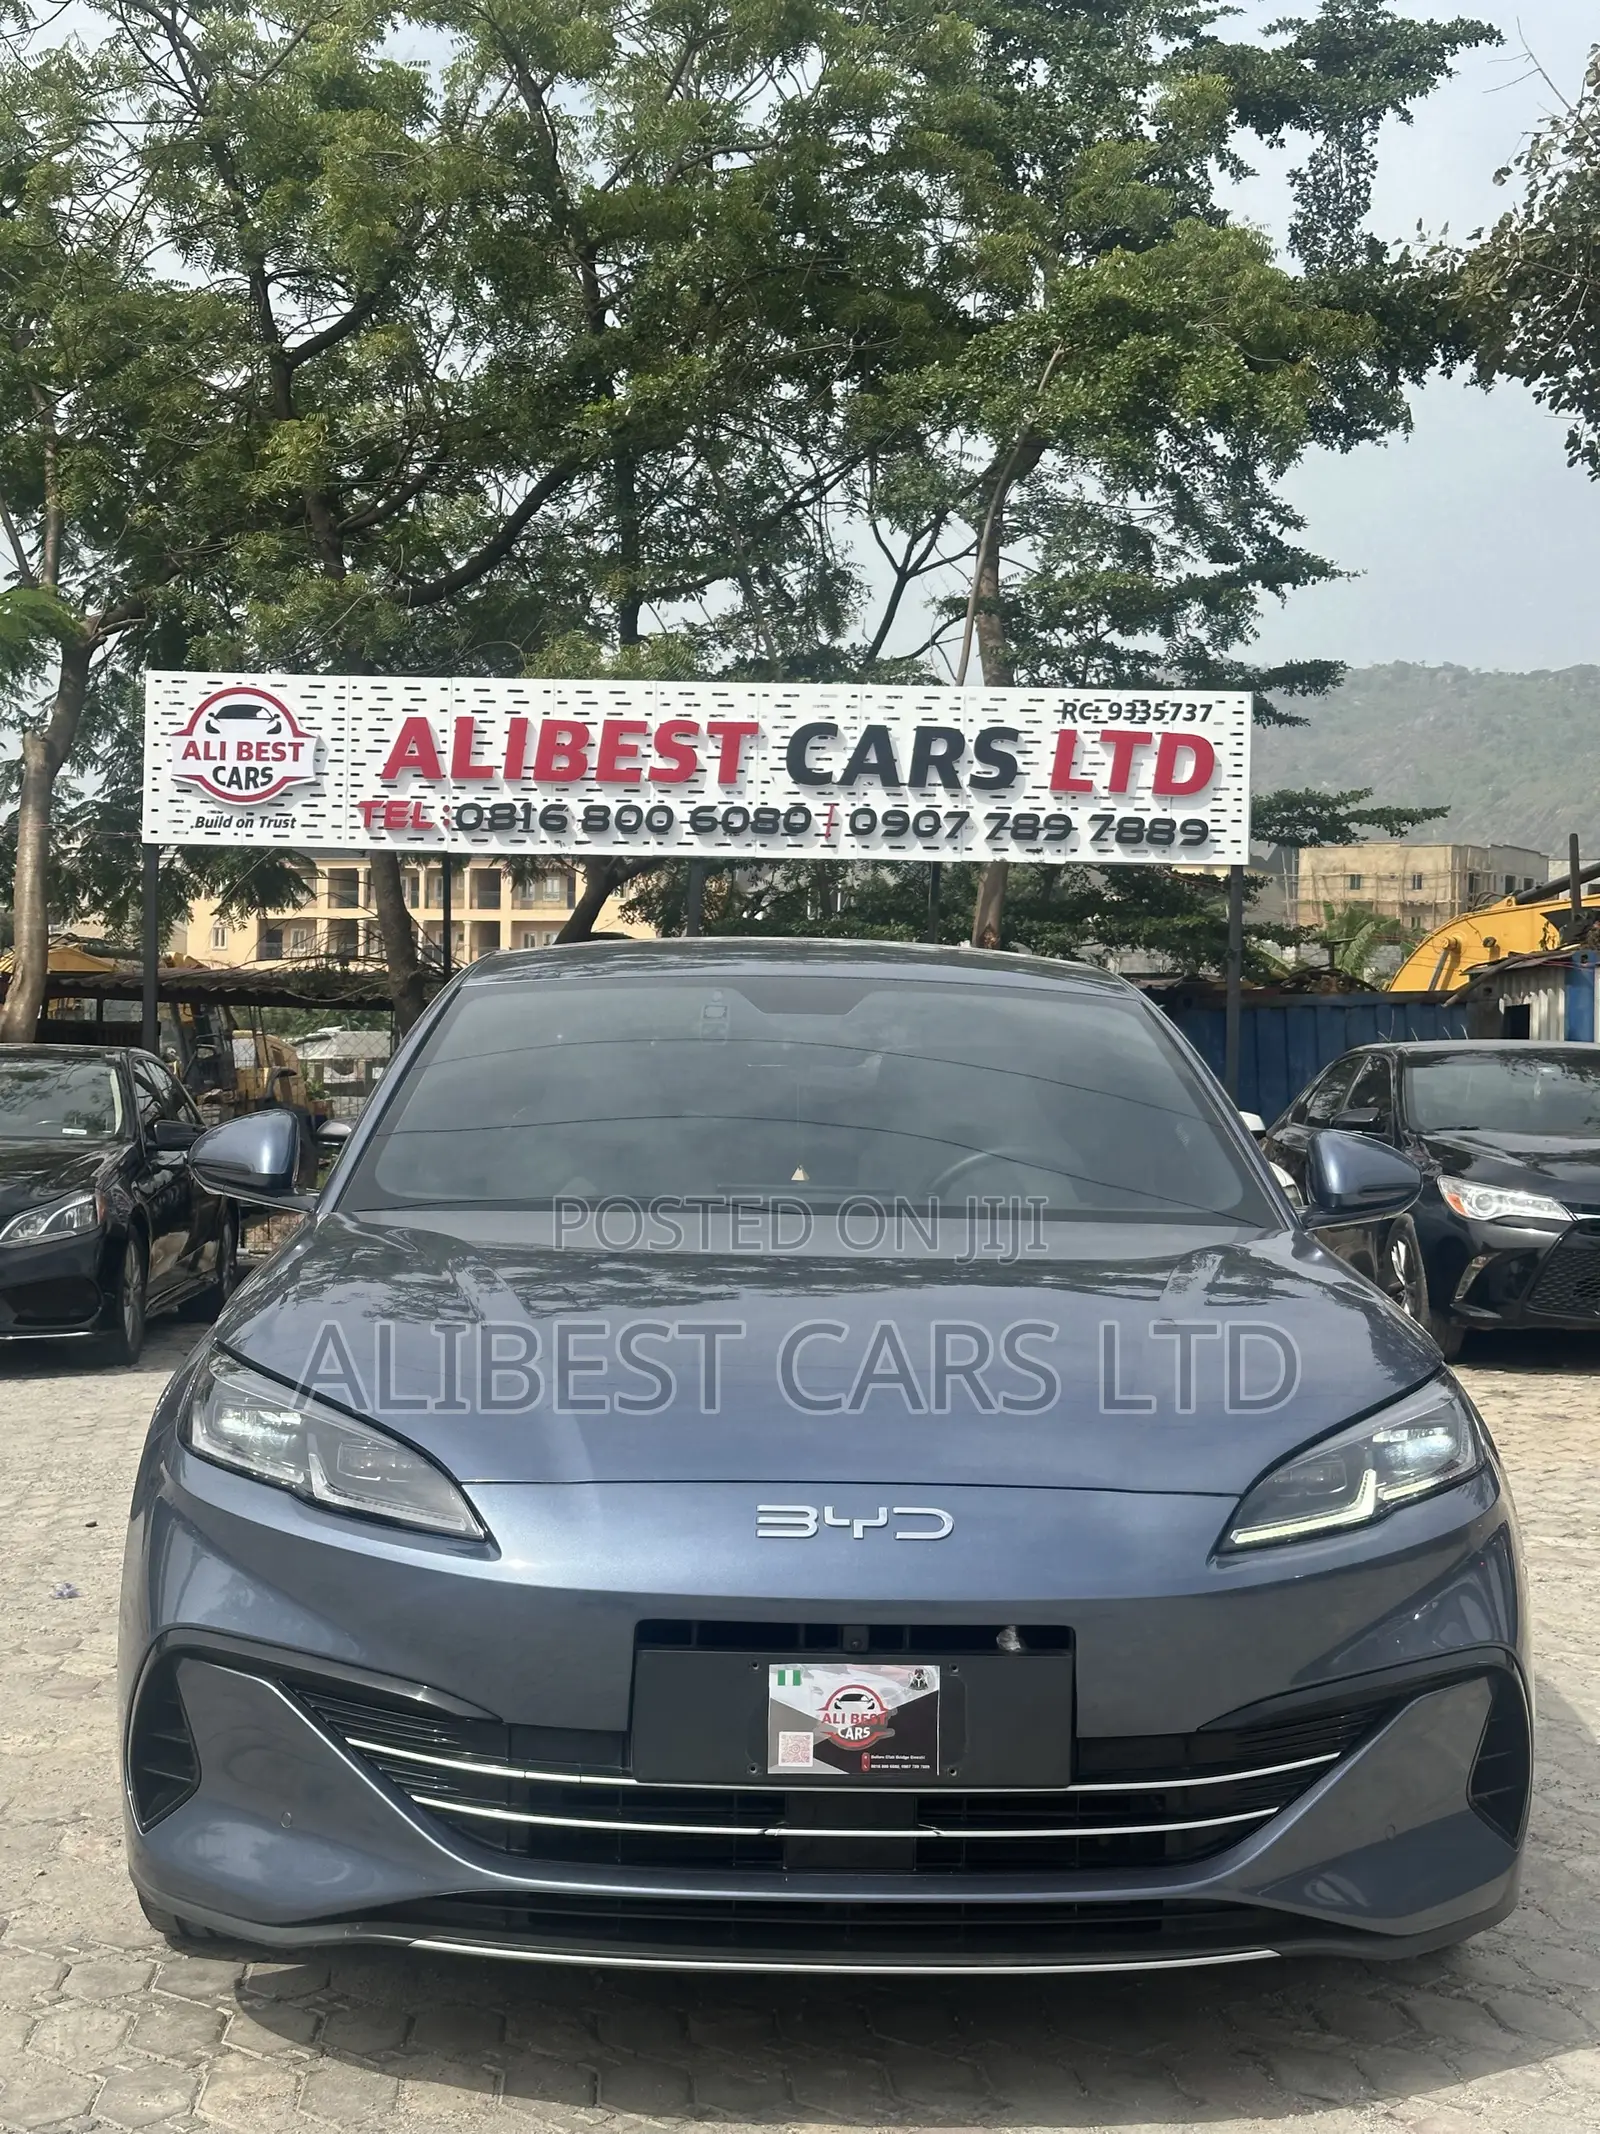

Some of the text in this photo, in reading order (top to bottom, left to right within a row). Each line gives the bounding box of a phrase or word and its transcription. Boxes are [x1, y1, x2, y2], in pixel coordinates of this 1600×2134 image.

[1108, 702, 1213, 723] 9335737
[181, 740, 305, 762] ALI BEST
[379, 716, 1215, 796] ALIBEST CARS LTD
[212, 765, 274, 790] CARS
[236, 818, 254, 829] on
[259, 816, 297, 829] Trust
[455, 802, 569, 833] 0816
[581, 804, 674, 834] 800
[689, 806, 812, 836] 6080
[849, 808, 970, 838] 0907
[984, 812, 1074, 842] 789
[1088, 813, 1210, 846] 7889
[756, 1504, 955, 1540] BYD
[821, 1712, 887, 1726] ALI BEST
[837, 1726, 871, 1740] CARS
